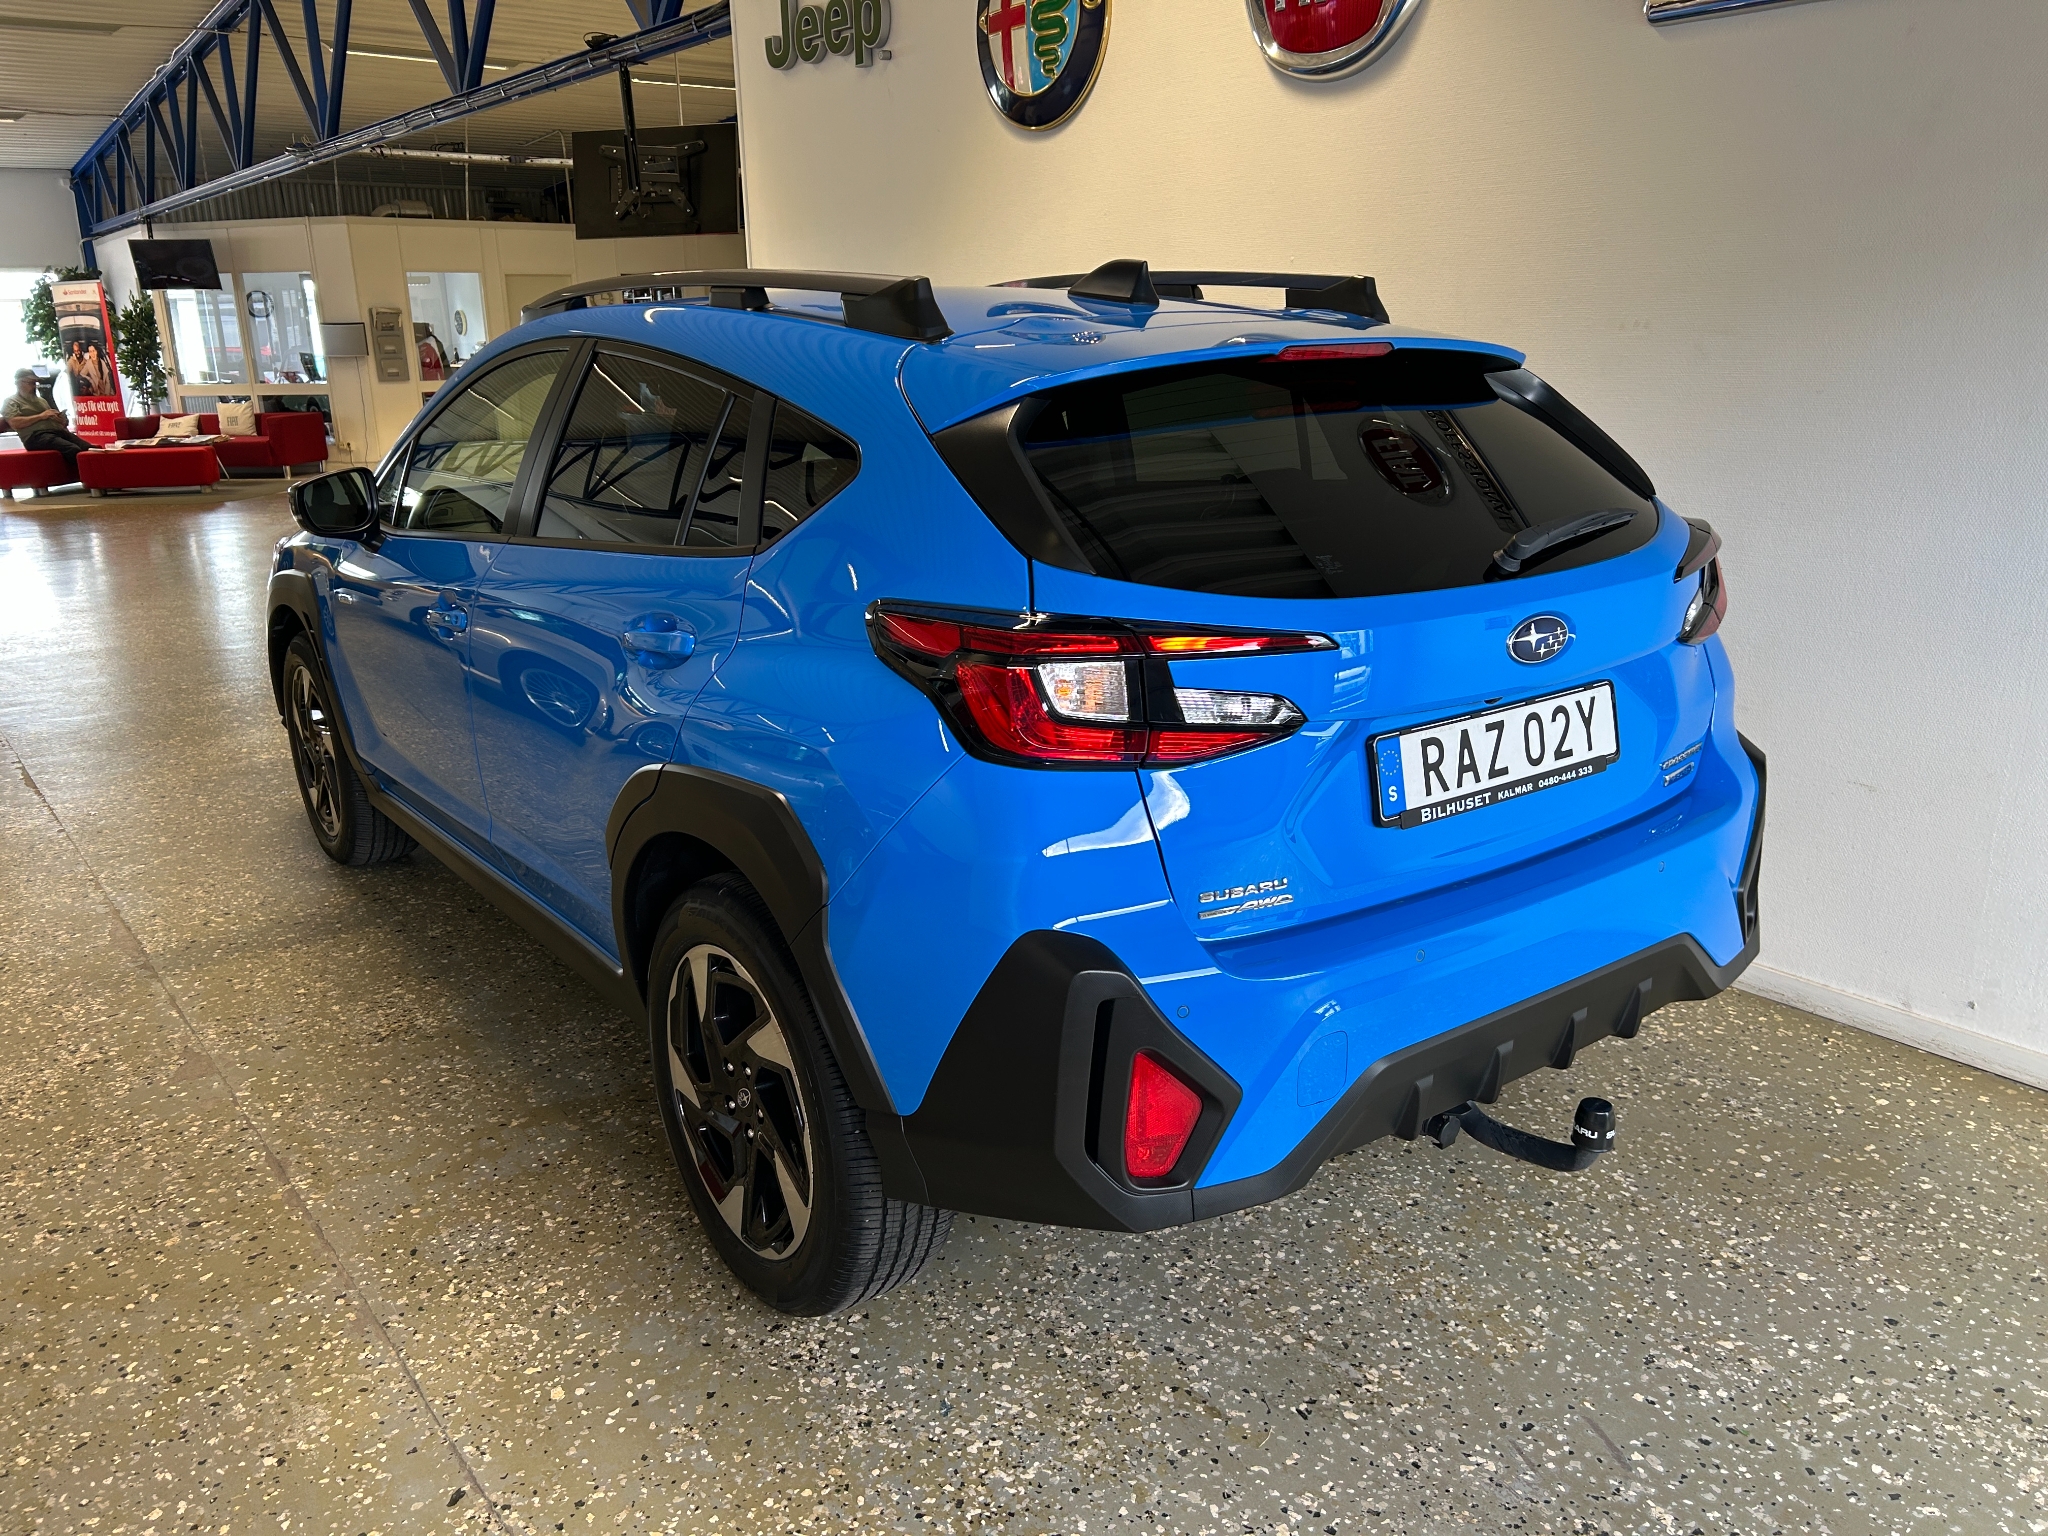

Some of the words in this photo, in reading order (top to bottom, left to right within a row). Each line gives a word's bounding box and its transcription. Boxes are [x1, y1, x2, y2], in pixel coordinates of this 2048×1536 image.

[764, 0, 889, 70] Jeep
[227, 416, 239, 427] FIAT
[1420, 719, 1509, 797] RAZ
[1523, 696, 1596, 767] 02Y
[1388, 786, 1398, 802] S
[1421, 792, 1492, 823] BILHUSET
[1497, 783, 1533, 800] KALMAR
[1538, 769, 1577, 788] 0480-444
[1578, 765, 1593, 777] 333
[1199, 877, 1288, 904] SUBARU
